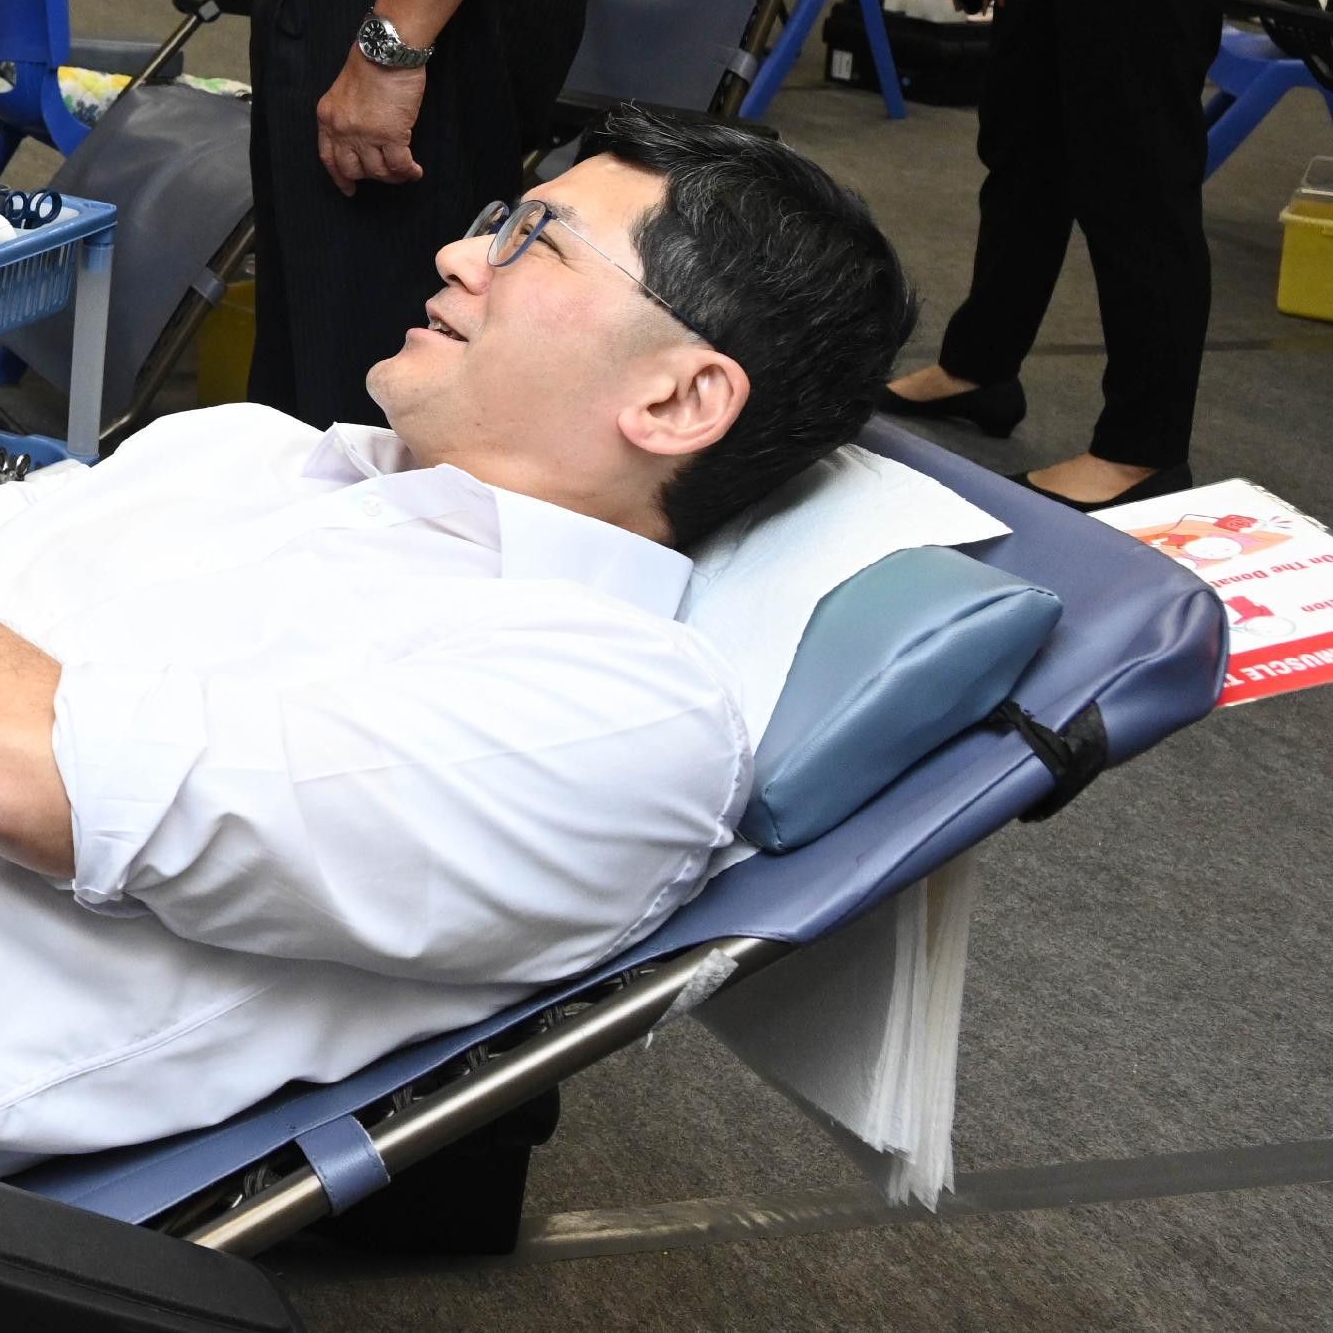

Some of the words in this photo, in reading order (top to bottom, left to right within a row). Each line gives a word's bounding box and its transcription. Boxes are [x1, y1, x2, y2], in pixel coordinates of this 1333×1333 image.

[1308, 552, 1333, 567] On
[1270, 562, 1309, 575] The
[1240, 649, 1333, 681] MUSCLE
